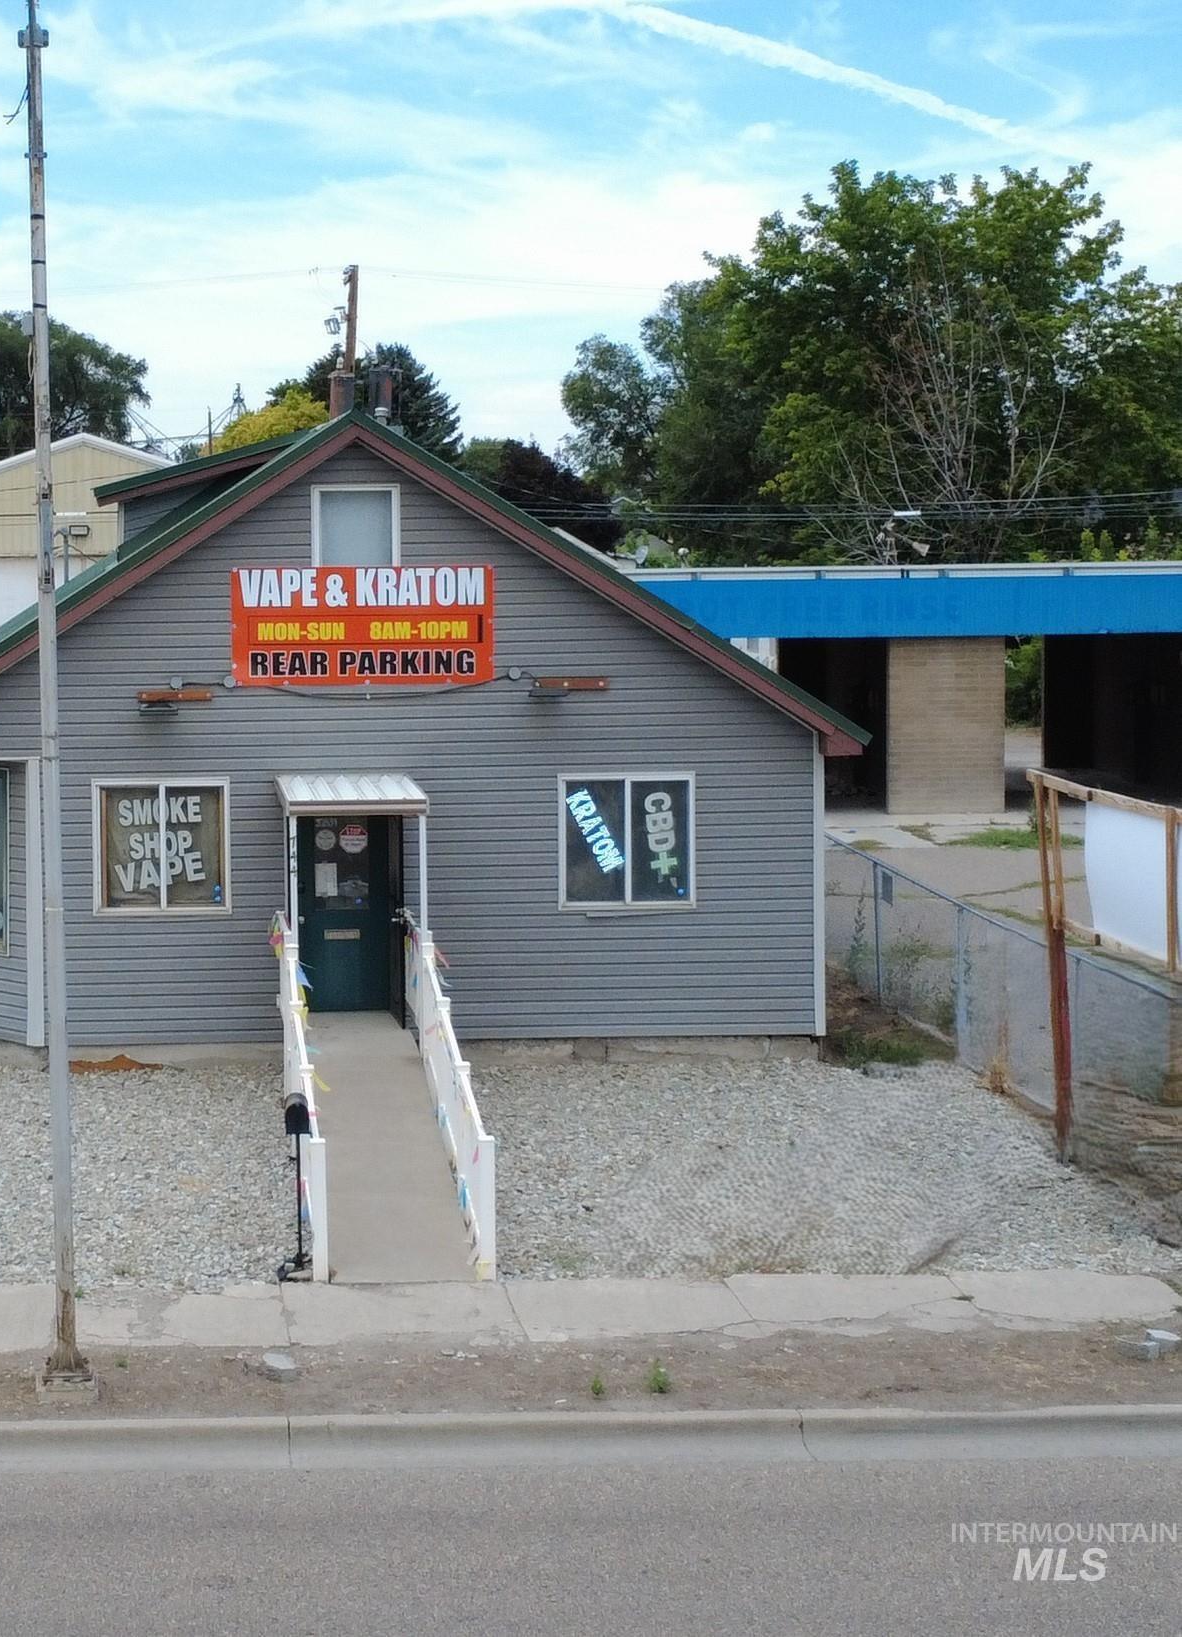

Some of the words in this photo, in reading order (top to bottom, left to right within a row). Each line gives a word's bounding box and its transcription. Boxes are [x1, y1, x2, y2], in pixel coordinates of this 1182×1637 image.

[239, 568, 317, 608] VAPE
[325, 574, 348, 607] &
[356, 567, 485, 606] KRATOM
[258, 621, 345, 641] MON-SUN
[370, 620, 468, 640] 8AM-10PM
[249, 650, 329, 678] REAR
[338, 648, 476, 676] PARKING
[118, 795, 202, 826] SMOKE
[129, 830, 193, 860] SHOP
[566, 788, 625, 873] KRATOM
[114, 851, 206, 893] VAPE
